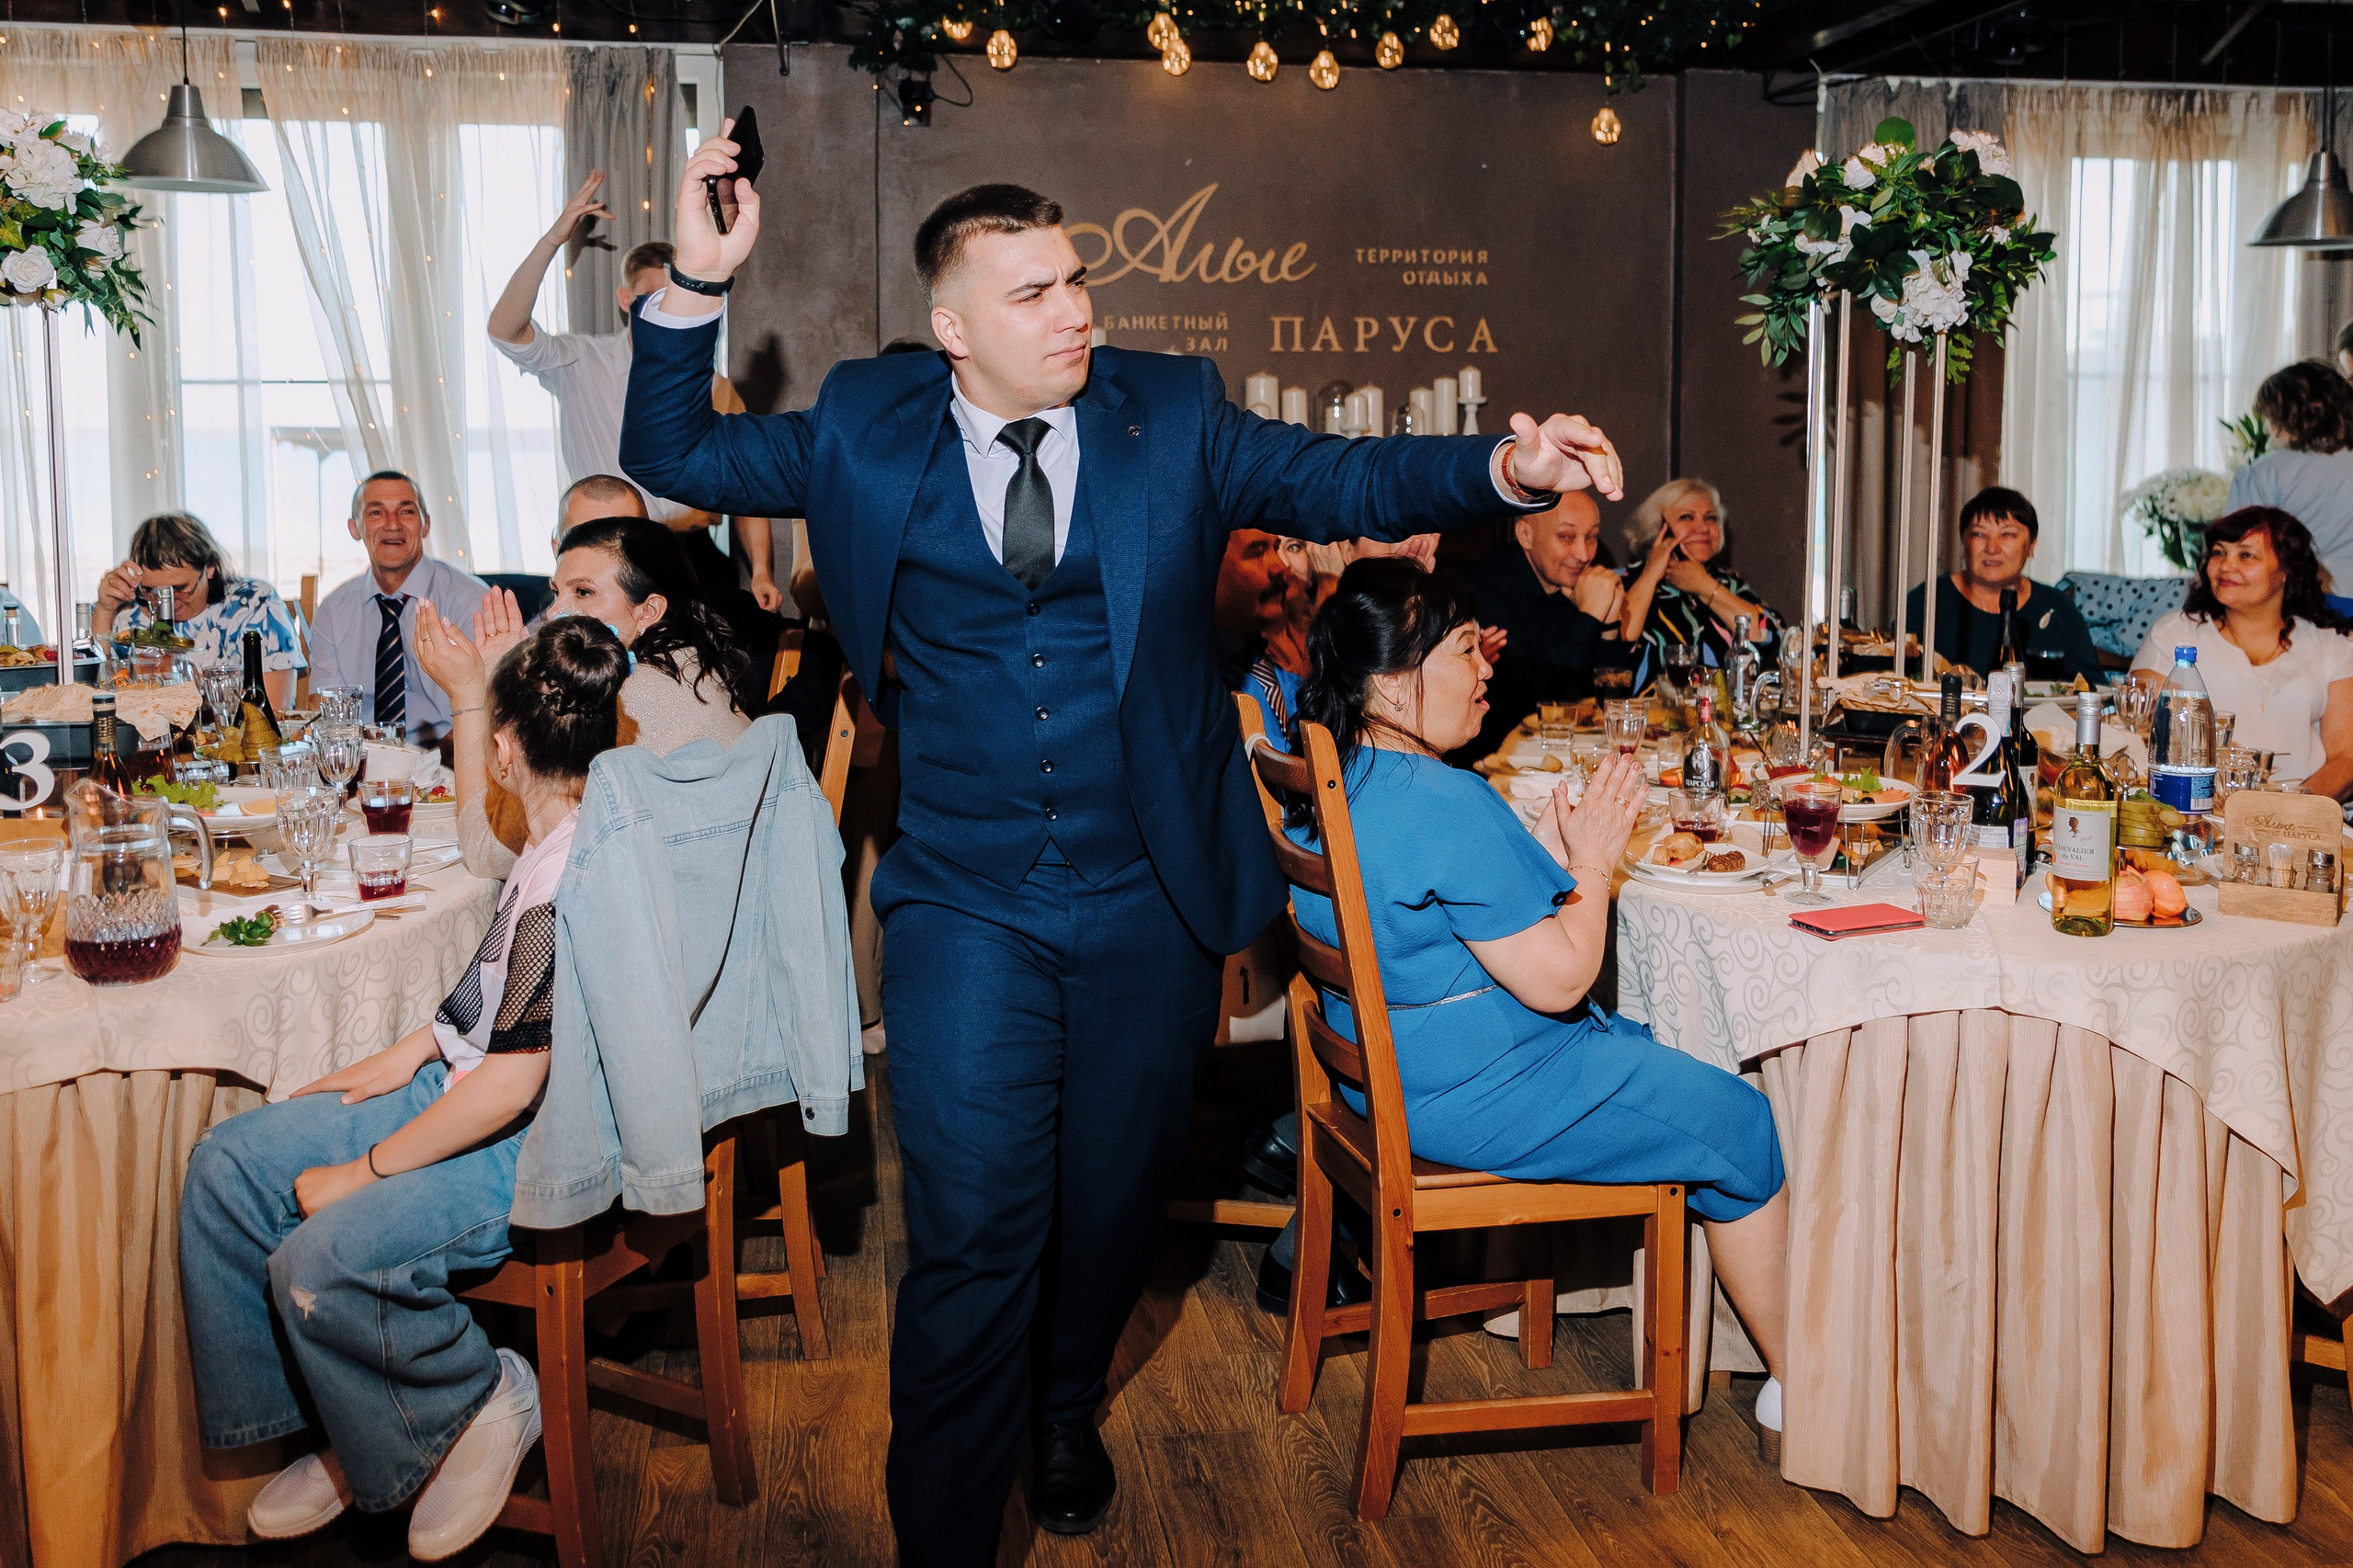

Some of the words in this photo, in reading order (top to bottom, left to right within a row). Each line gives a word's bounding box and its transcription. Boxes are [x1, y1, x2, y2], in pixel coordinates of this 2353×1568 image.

[1063, 182, 1318, 288] Алые
[1355, 247, 1489, 265] ТЕРРИТОРИЯ
[1402, 269, 1489, 287] ОТДЫХА
[1103, 311, 1229, 332] БАНКЕТНЫЙ
[1269, 315, 1499, 353] ПАРУСА
[1186, 335, 1228, 352] ЗАЛ
[1951, 711, 2006, 788] 2
[0, 730, 56, 811] 3
[1685, 778, 1715, 788] ЦАРСКАЯ
[2283, 831, 2322, 840] ПАРУСА
[2055, 844, 2095, 855] CHEVALIER
